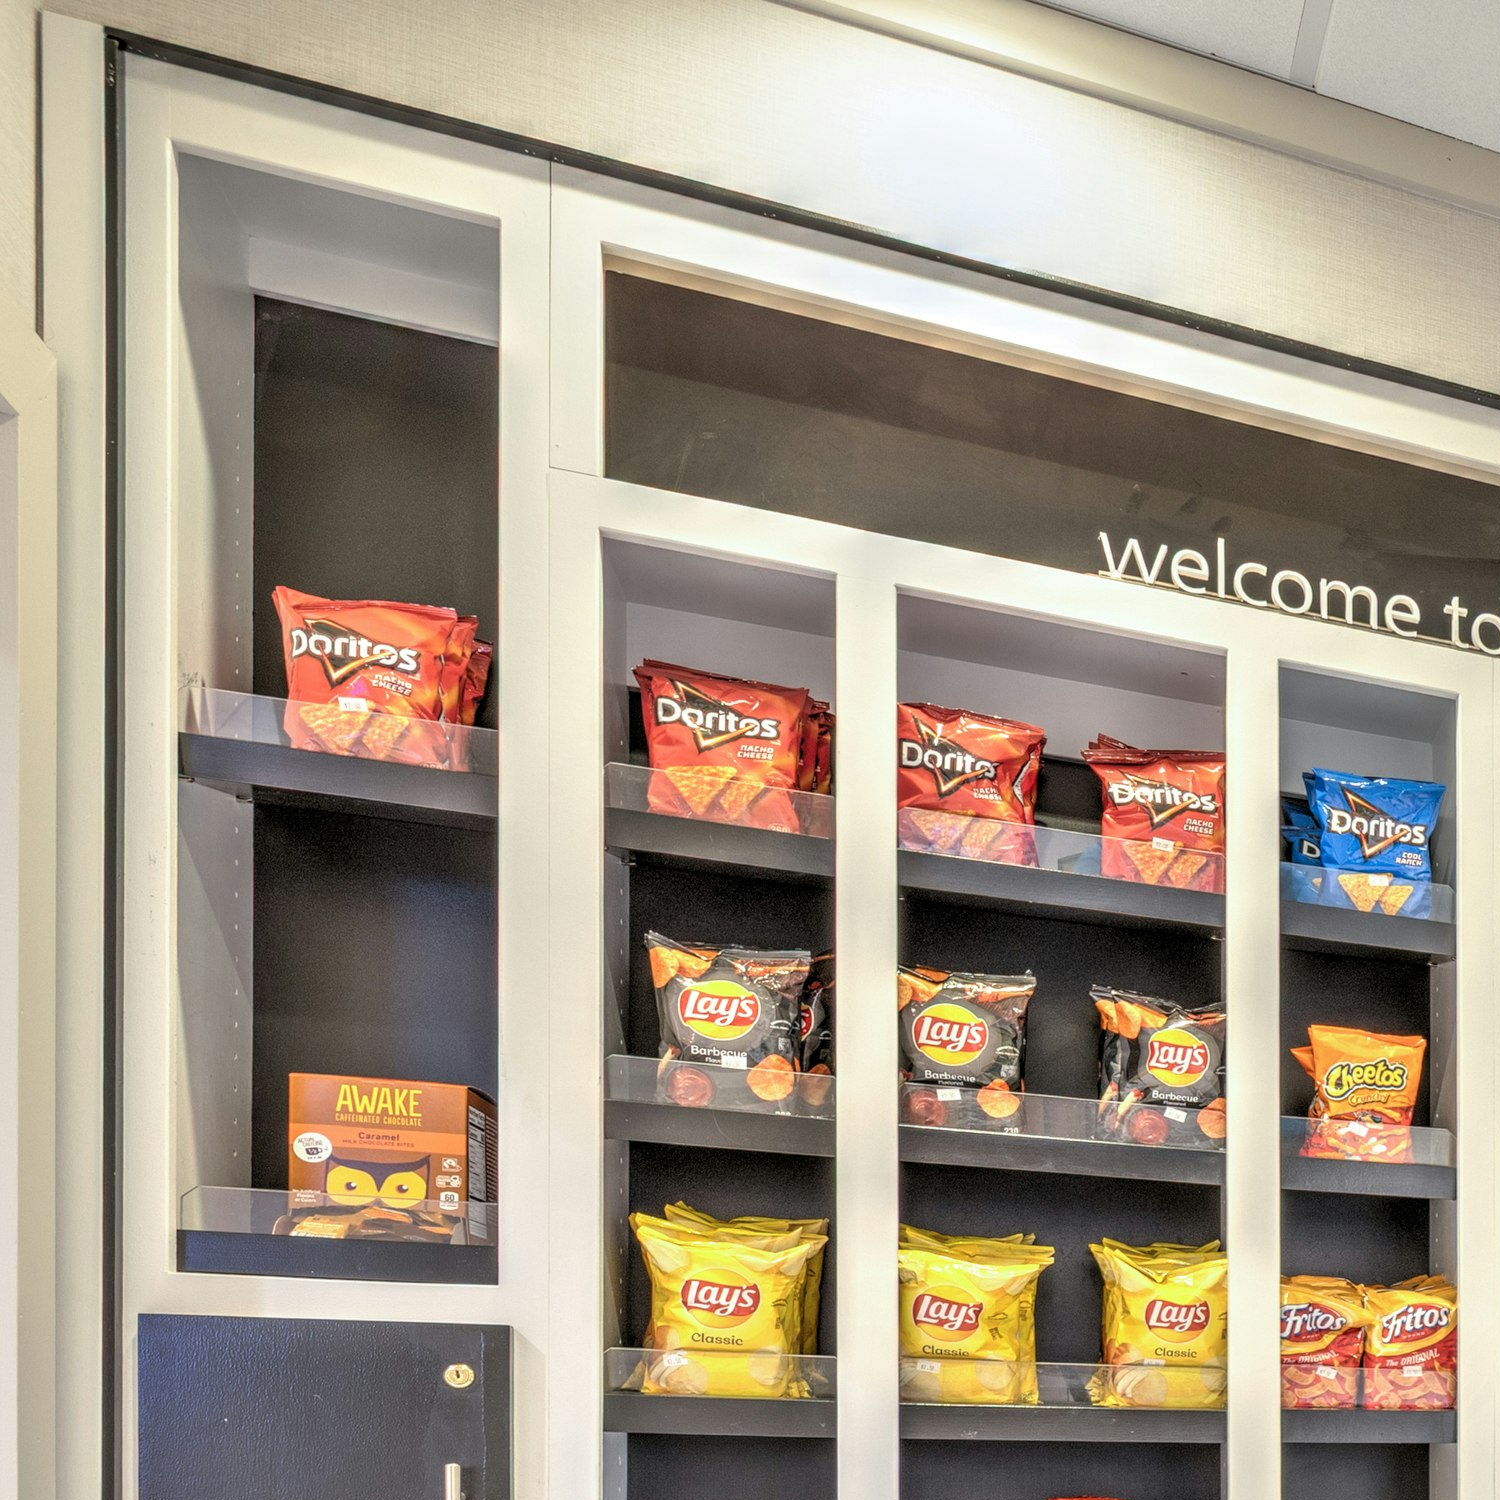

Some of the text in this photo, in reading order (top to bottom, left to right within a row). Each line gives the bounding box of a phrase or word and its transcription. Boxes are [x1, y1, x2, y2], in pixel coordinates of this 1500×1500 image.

[1099, 531, 1418, 638] welcome
[291, 629, 418, 672] Doritos
[372, 679, 412, 696] CHEESE
[374, 674, 412, 688] NACHO
[656, 697, 779, 738] Doritos
[737, 751, 774, 760] CHEESE
[740, 745, 774, 754] NACHO
[1109, 782, 1216, 811] Doritos
[1183, 824, 1214, 835] CHEESE
[1186, 818, 1214, 828] NACHO
[1330, 809, 1427, 844] Doritos
[1395, 858, 1422, 866] RANCH
[1402, 852, 1422, 860] COOL
[684, 990, 756, 1026] Lay's
[917, 1017, 985, 1052] Lay's
[691, 1045, 748, 1059] Barbecue
[1149, 1041, 1205, 1074] Lay's
[924, 1070, 976, 1083] Barbecue
[1324, 1059, 1407, 1099] Cheetos
[335, 1084, 422, 1117] AWAKE
[1152, 1090, 1198, 1103] Barbecue
[1349, 1093, 1391, 1107] Crunchy
[335, 1113, 422, 1127] CAFFEINATED CHOCOLATE
[358, 1131, 400, 1142] Caramel
[687, 1281, 756, 1316] Lay's
[916, 1295, 979, 1332] Lay's
[1281, 1303, 1347, 1339] Fritos
[1382, 1305, 1450, 1344] Fritos
[691, 1333, 744, 1346] Classic
[922, 1345, 970, 1358] Classic
[1299, 1350, 1339, 1363] ORIGINAL
